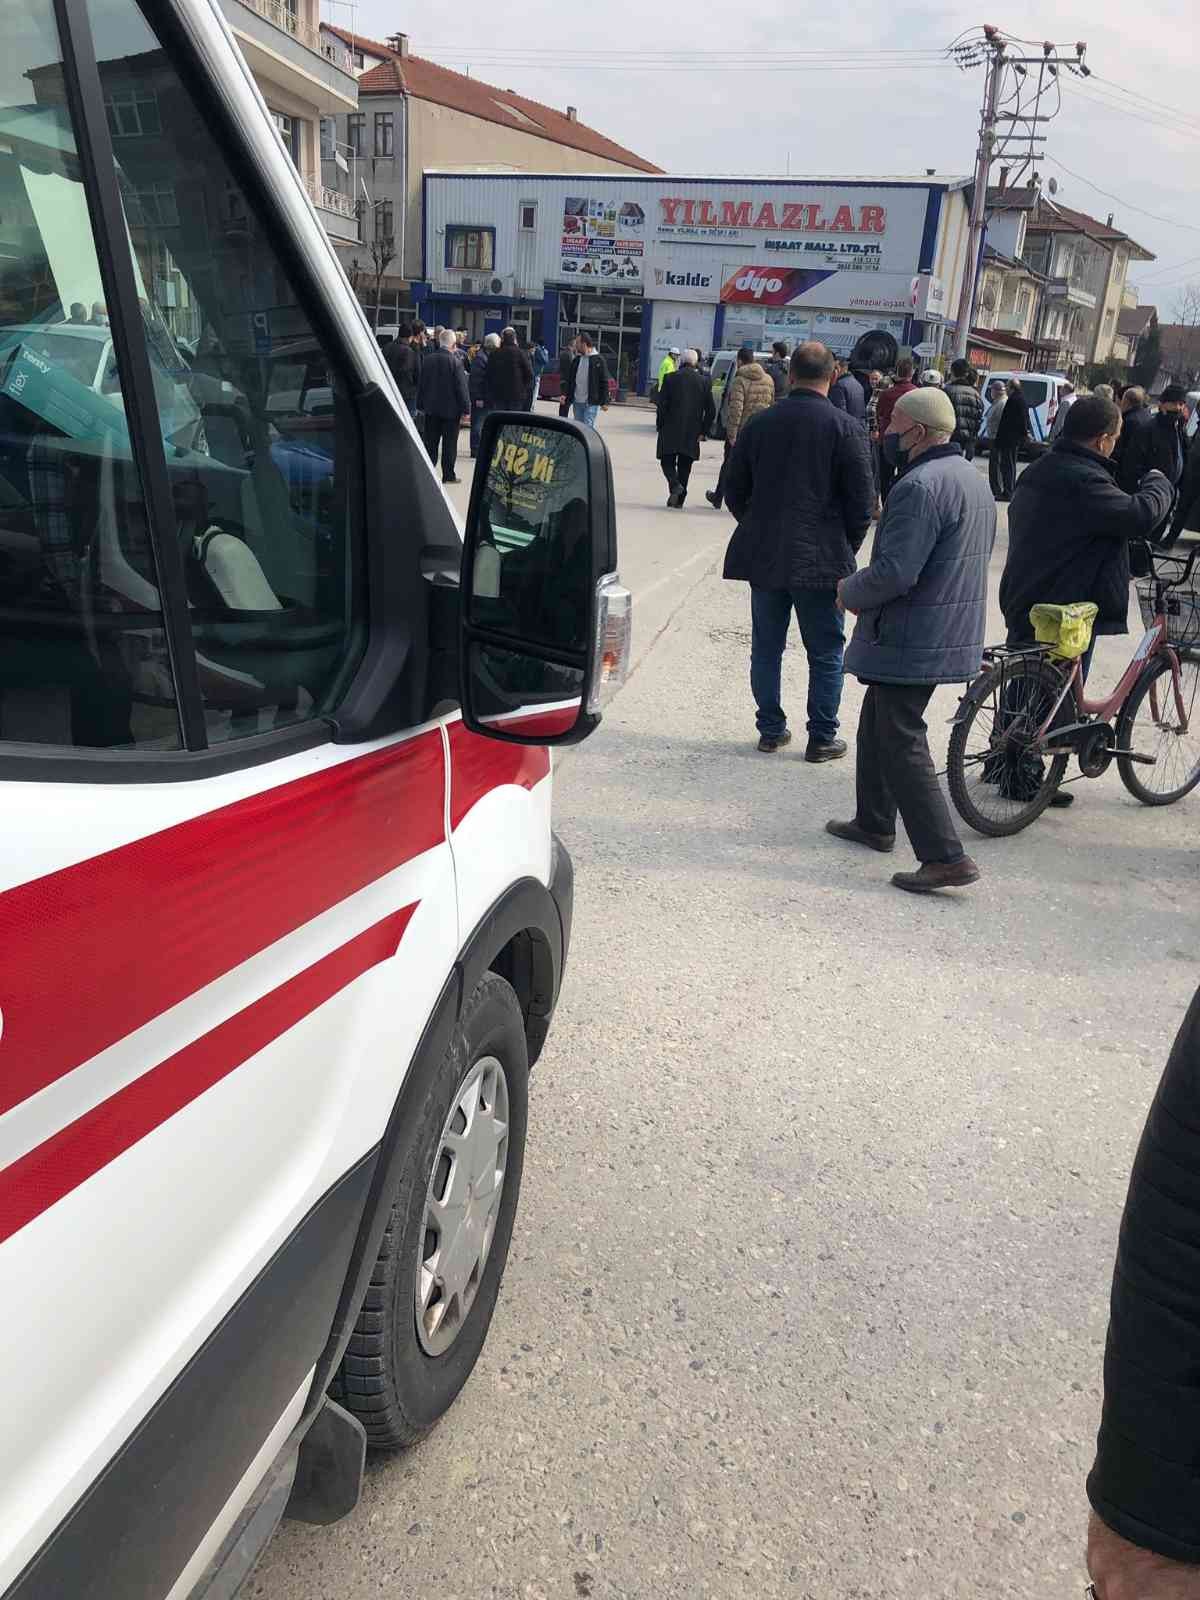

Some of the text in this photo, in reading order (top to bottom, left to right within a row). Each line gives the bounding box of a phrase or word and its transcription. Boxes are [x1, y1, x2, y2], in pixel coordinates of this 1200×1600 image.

[658, 198, 888, 234] YILMAZLAR
[665, 271, 711, 287] kalde
[735, 270, 783, 299] dyo
